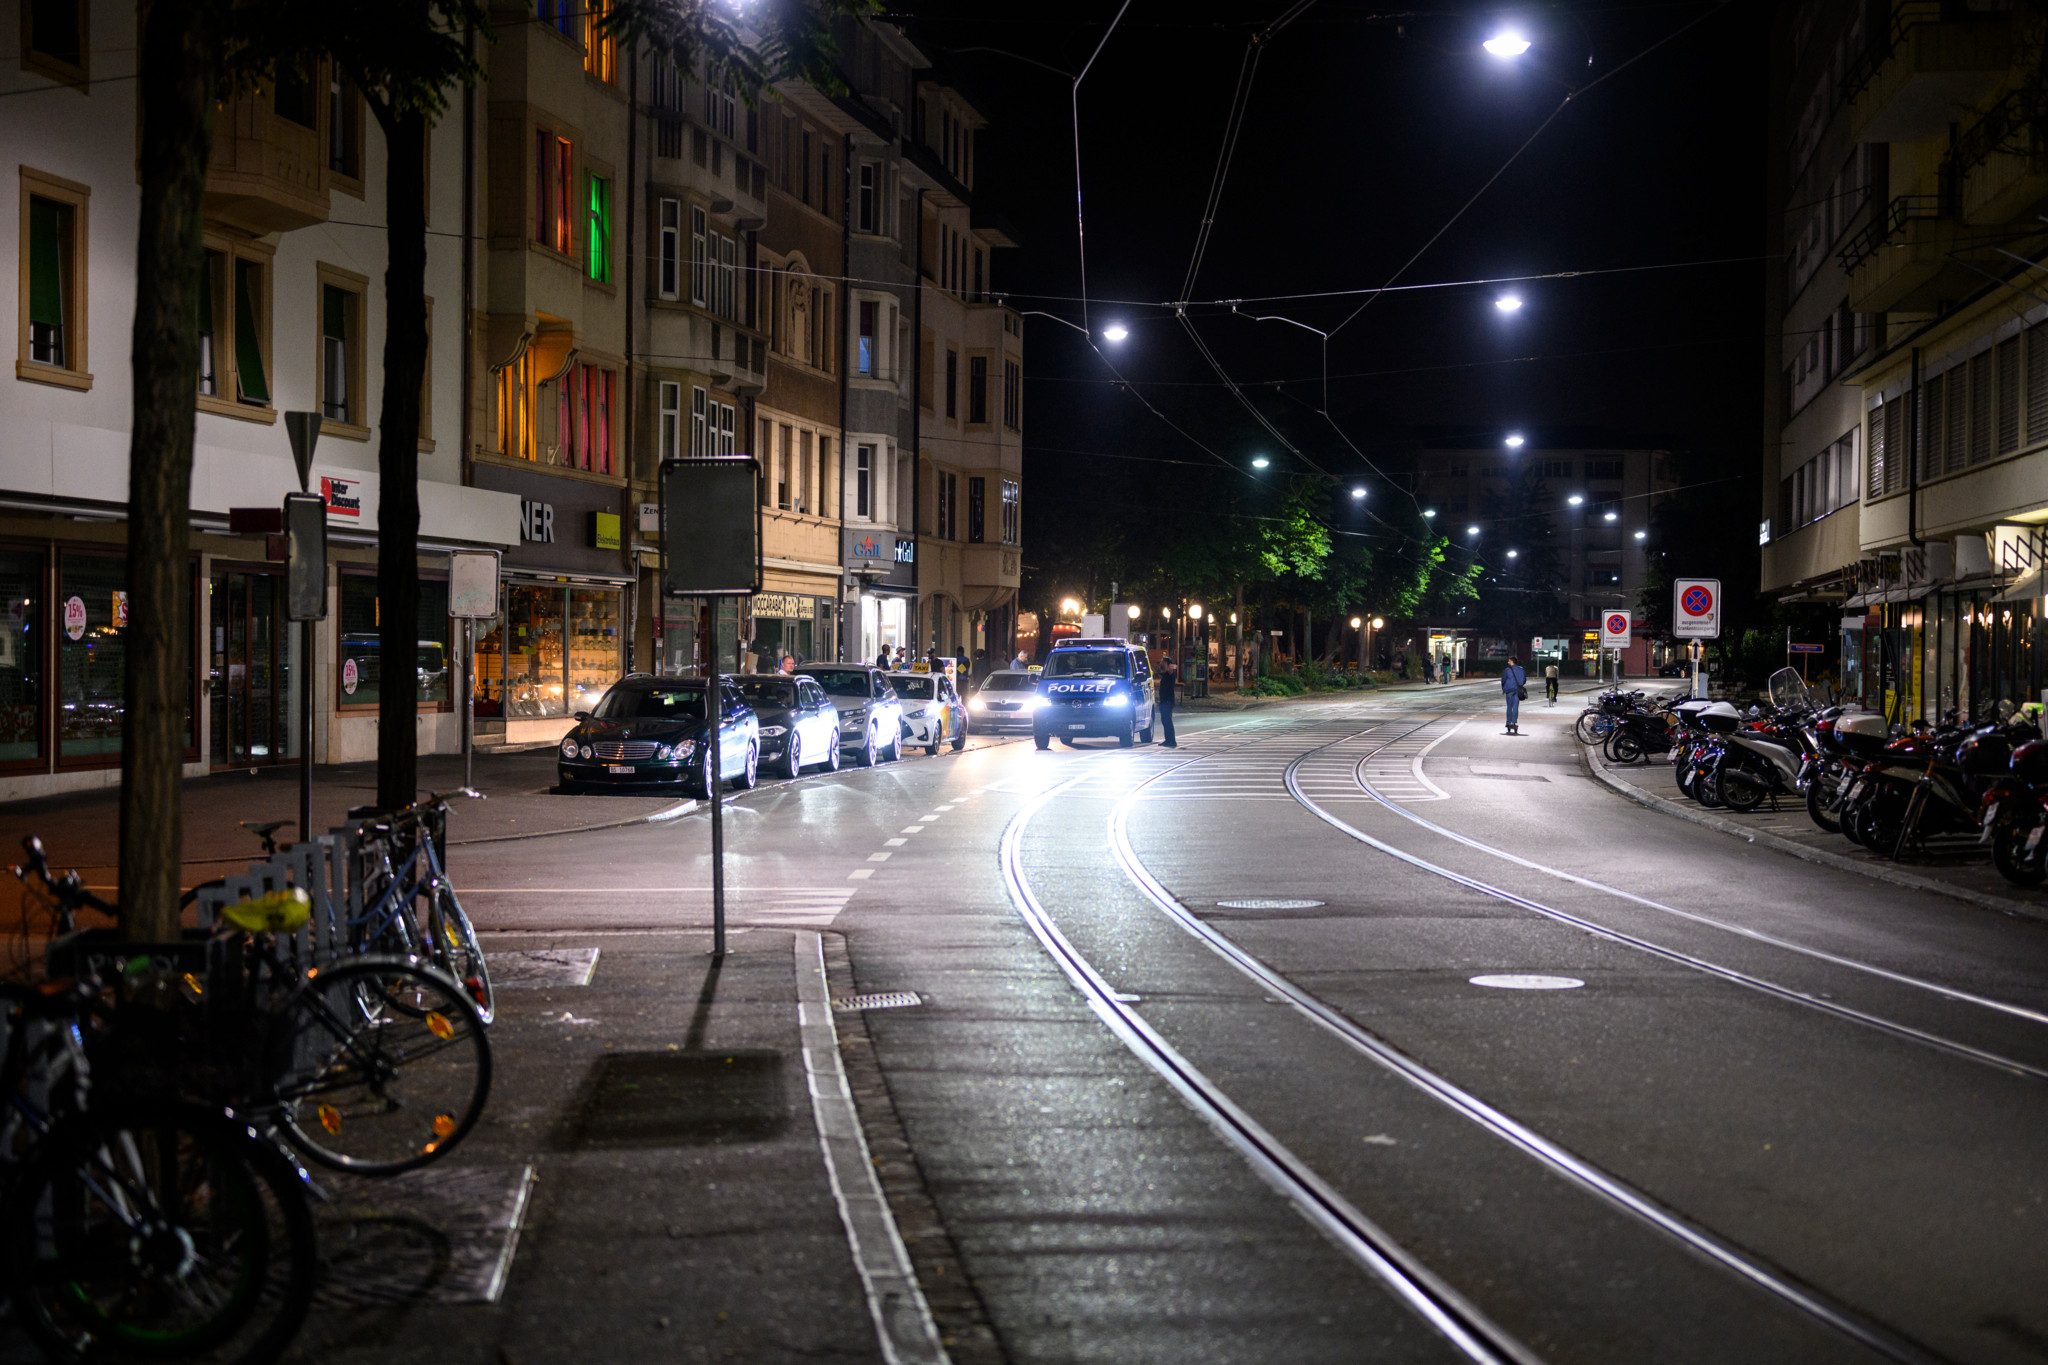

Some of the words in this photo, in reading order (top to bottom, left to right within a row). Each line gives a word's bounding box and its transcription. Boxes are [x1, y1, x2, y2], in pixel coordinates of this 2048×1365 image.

[331, 480, 348, 495] Inter
[331, 493, 360, 509] Discount
[68, 603, 83, 618] 15%
[1048, 680, 1116, 694] POLIZEI
